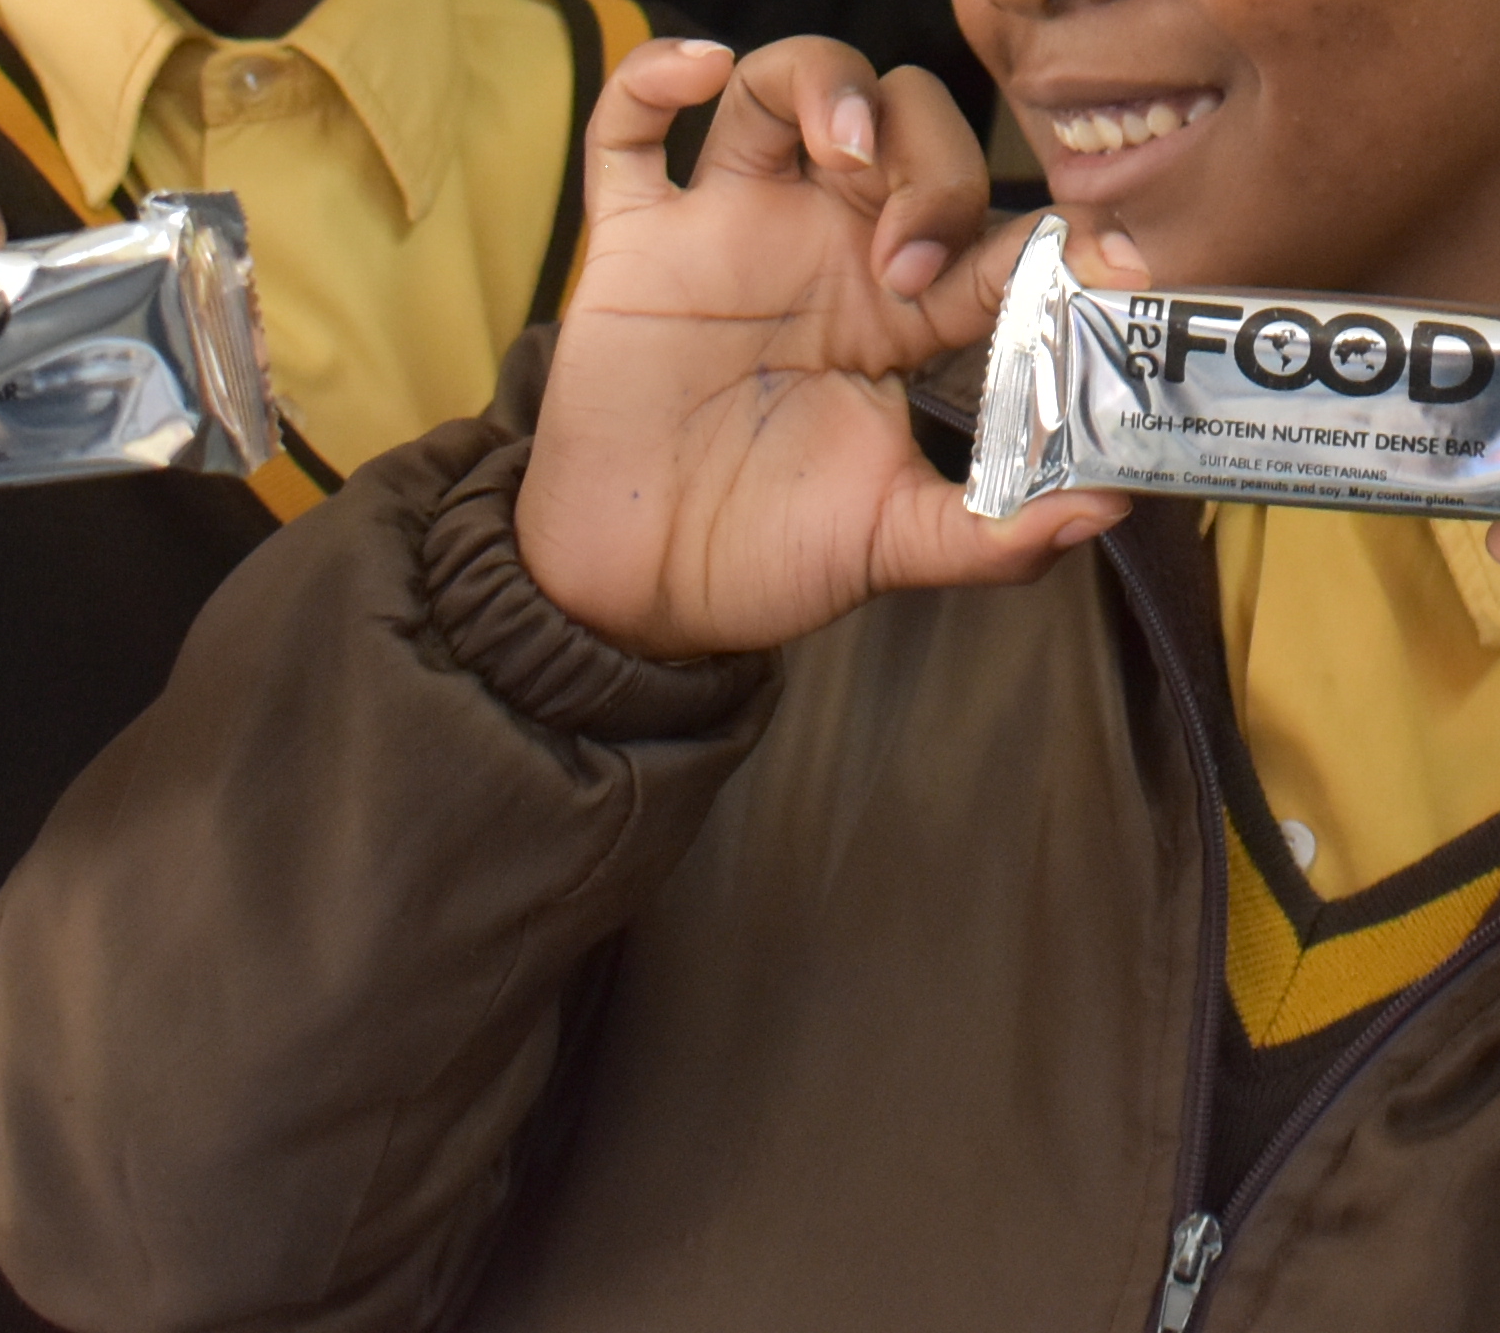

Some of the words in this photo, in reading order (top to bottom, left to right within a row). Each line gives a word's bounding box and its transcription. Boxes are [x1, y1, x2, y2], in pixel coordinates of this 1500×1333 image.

[1126, 295, 1162, 382] E2G
[1162, 299, 1496, 405] FOOD
[1120, 411, 1266, 440] HIGH-PROTEIN
[1272, 424, 1369, 449] NUTRIENT
[1375, 433, 1440, 455] DENSE
[1445, 438, 1486, 459] BAR
[1183, 471, 1237, 487] Contains
[1240, 477, 1289, 493] peanuts
[1293, 484, 1315, 494] and
[1349, 487, 1373, 500] May
[1377, 492, 1422, 503] contain
[1200, 454, 1263, 471] SUITABLE
[1266, 460, 1293, 473] FOR
[1297, 463, 1388, 481] VEGETARIANS
